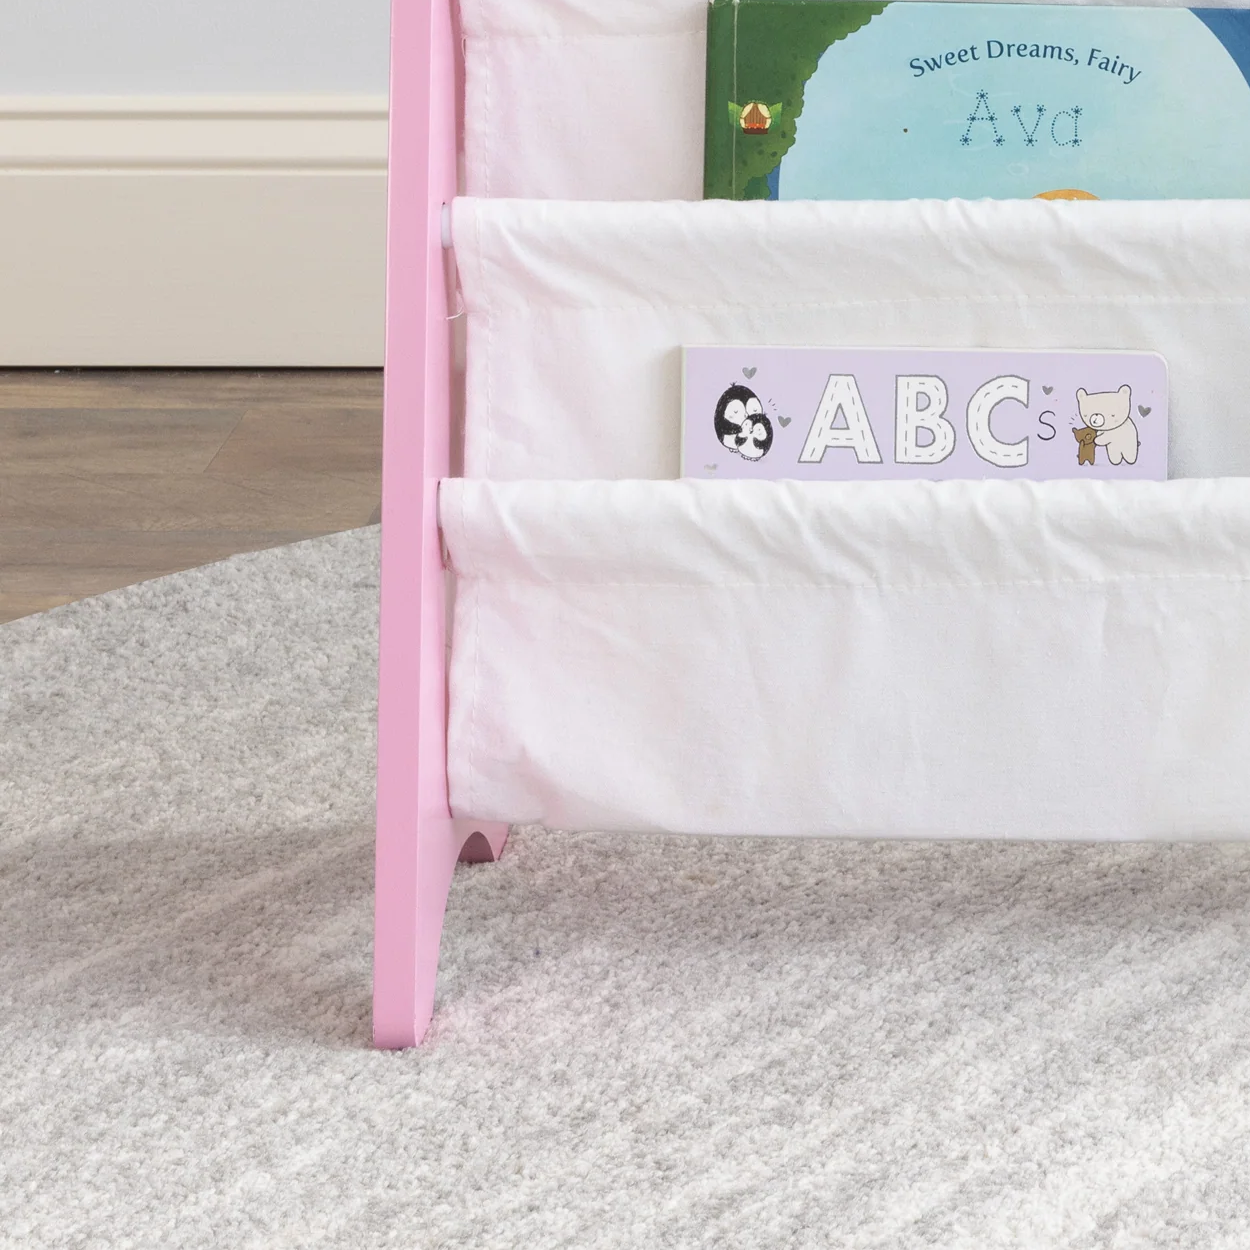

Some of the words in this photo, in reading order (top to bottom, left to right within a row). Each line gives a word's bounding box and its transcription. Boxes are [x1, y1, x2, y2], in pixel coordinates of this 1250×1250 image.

[909, 44, 981, 78] Sweet
[986, 39, 1080, 67] Dreams,
[1087, 48, 1142, 85] Fairy
[959, 89, 1083, 147] Ava
